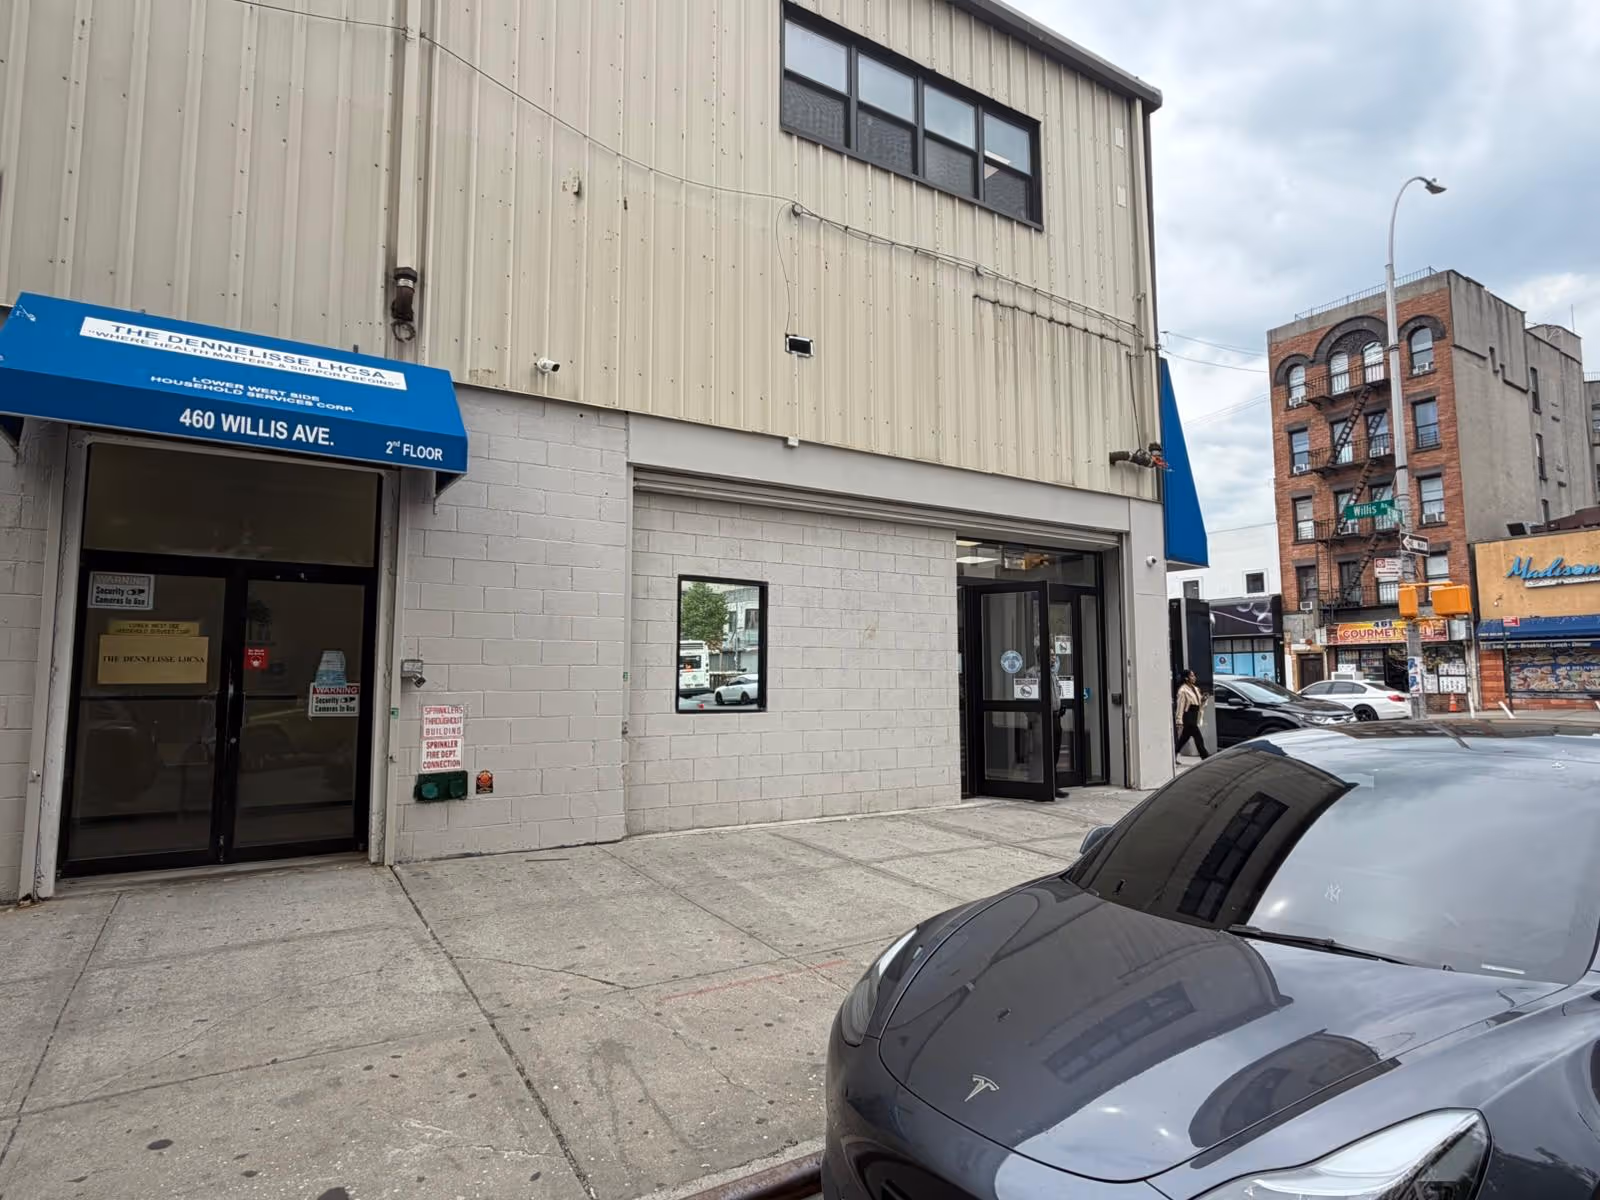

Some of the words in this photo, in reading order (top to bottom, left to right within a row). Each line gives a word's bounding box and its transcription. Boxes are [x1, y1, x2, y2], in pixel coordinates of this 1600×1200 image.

[111, 324, 159, 340] THE
[167, 334, 311, 366] DENNELISSE
[317, 360, 386, 379] LHCSA
[154, 341, 210, 356] HEALTH
[212, 351, 274, 368] MATTERS
[278, 362, 287, 370] &
[290, 365, 348, 379] SUPPORT
[150, 376, 243, 396] HOUSEHOLD
[246, 391, 314, 407] SERVICES
[316, 401, 355, 413] CORP.
[192, 377, 245, 390] LOWER
[248, 385, 289, 396] WEST
[290, 393, 320, 402] SIDE
[179, 408, 215, 431] 460
[221, 412, 289, 440] WILLIS
[292, 423, 334, 446] AVE.
[386, 440, 401, 455] 2nd
[402, 443, 443, 461] FLOOR
[1353, 505, 1377, 517] Willis
[1505, 556, 1600, 580] Madison
[95, 586, 125, 596] Security
[1373, 619, 1393, 628] 461
[1343, 628, 1399, 639] GOURMET
[103, 655, 119, 663] THE
[123, 655, 176, 663] DENNELISSE
[316, 687, 358, 695] WARNING
[315, 697, 339, 705] Security
[424, 706, 463, 714] SPRINKLERS
[425, 717, 462, 725] THROUGHOUT
[425, 727, 461, 736] BUILDING
[426, 740, 458, 750] SPRINKLER
[426, 751, 440, 759] FIRE
[422, 760, 460, 769] CONNECTION
